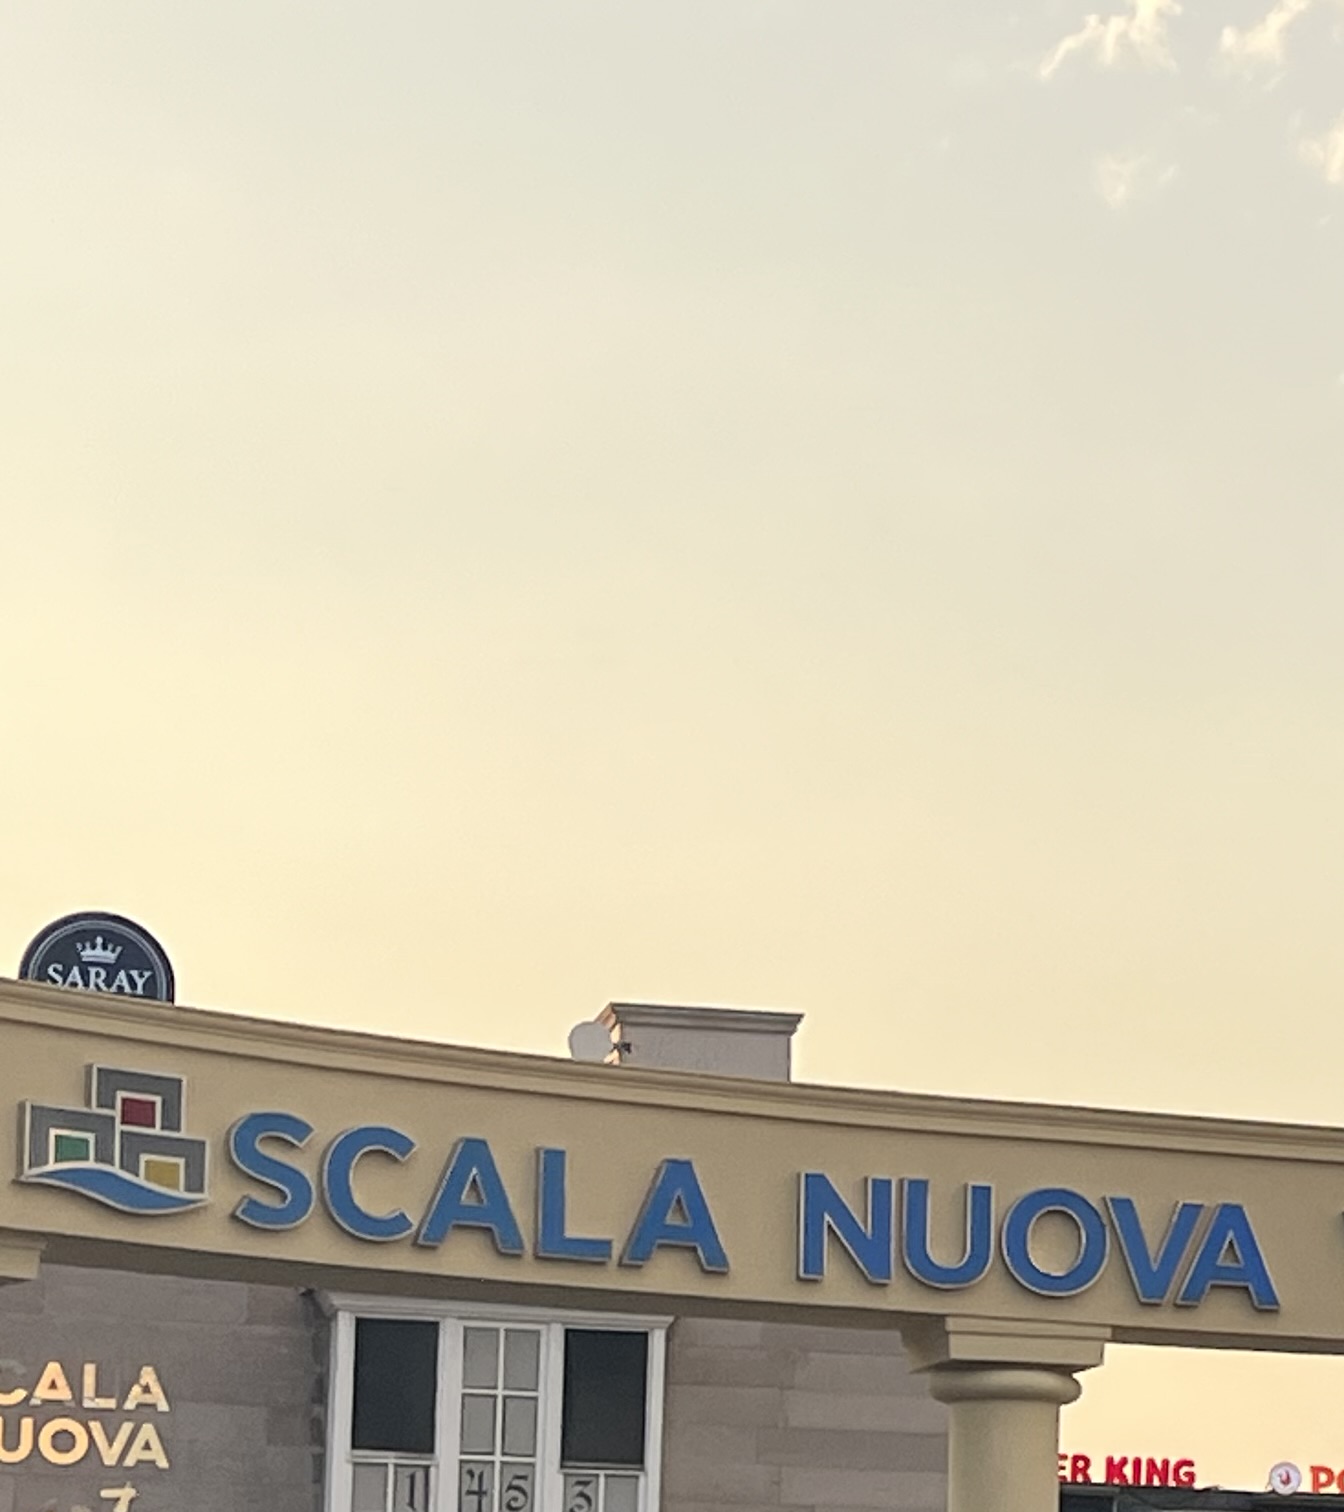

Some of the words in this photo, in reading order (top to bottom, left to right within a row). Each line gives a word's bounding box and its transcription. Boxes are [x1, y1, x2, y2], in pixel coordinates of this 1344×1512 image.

[46, 962, 152, 995] SARAY
[228, 1111, 729, 1273] SCALA
[796, 1172, 1281, 1311] NUOVA
[1105, 1455, 1197, 1487] KING
